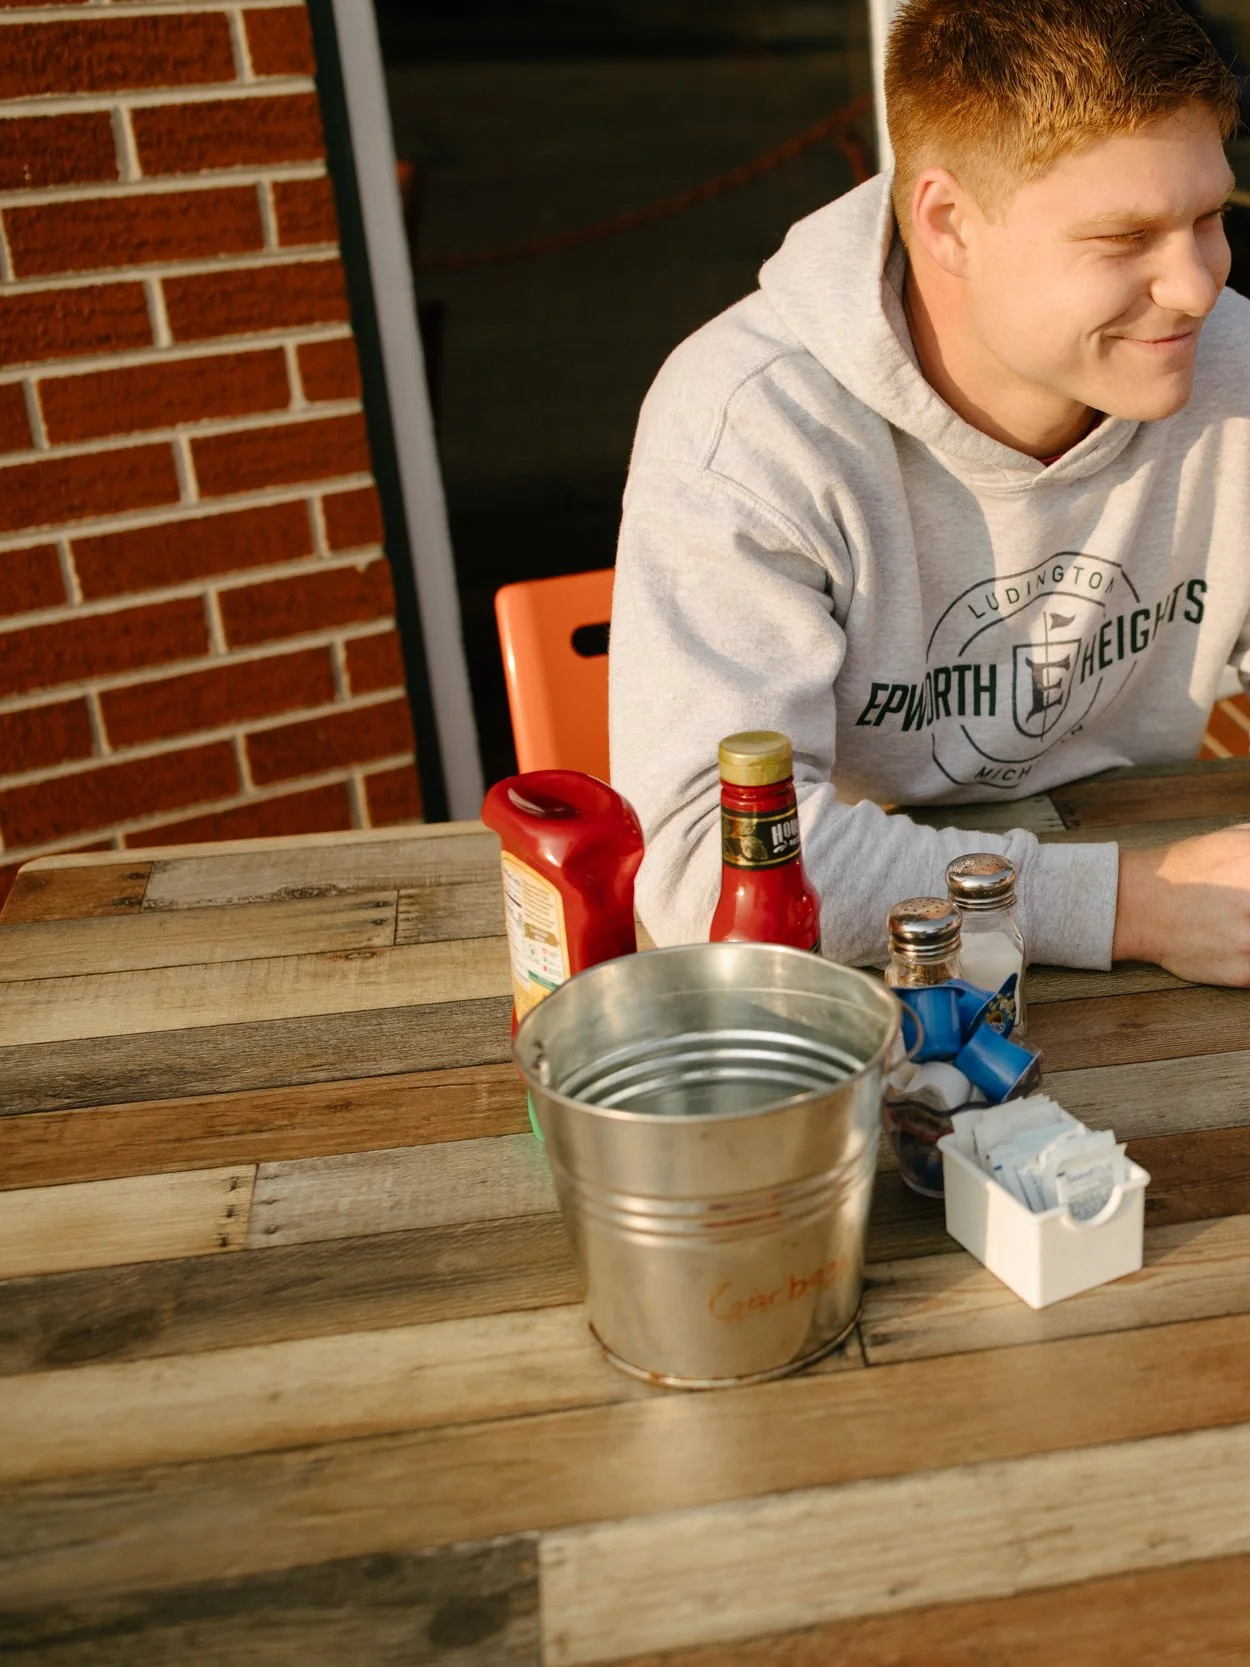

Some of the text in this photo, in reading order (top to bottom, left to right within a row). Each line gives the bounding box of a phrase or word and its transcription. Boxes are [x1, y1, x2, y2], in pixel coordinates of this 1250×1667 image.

[967, 564, 1114, 620] LUDINGTON
[854, 578, 1208, 732] EPWORTH HEIGHTS
[771, 820, 800, 846] HOU
